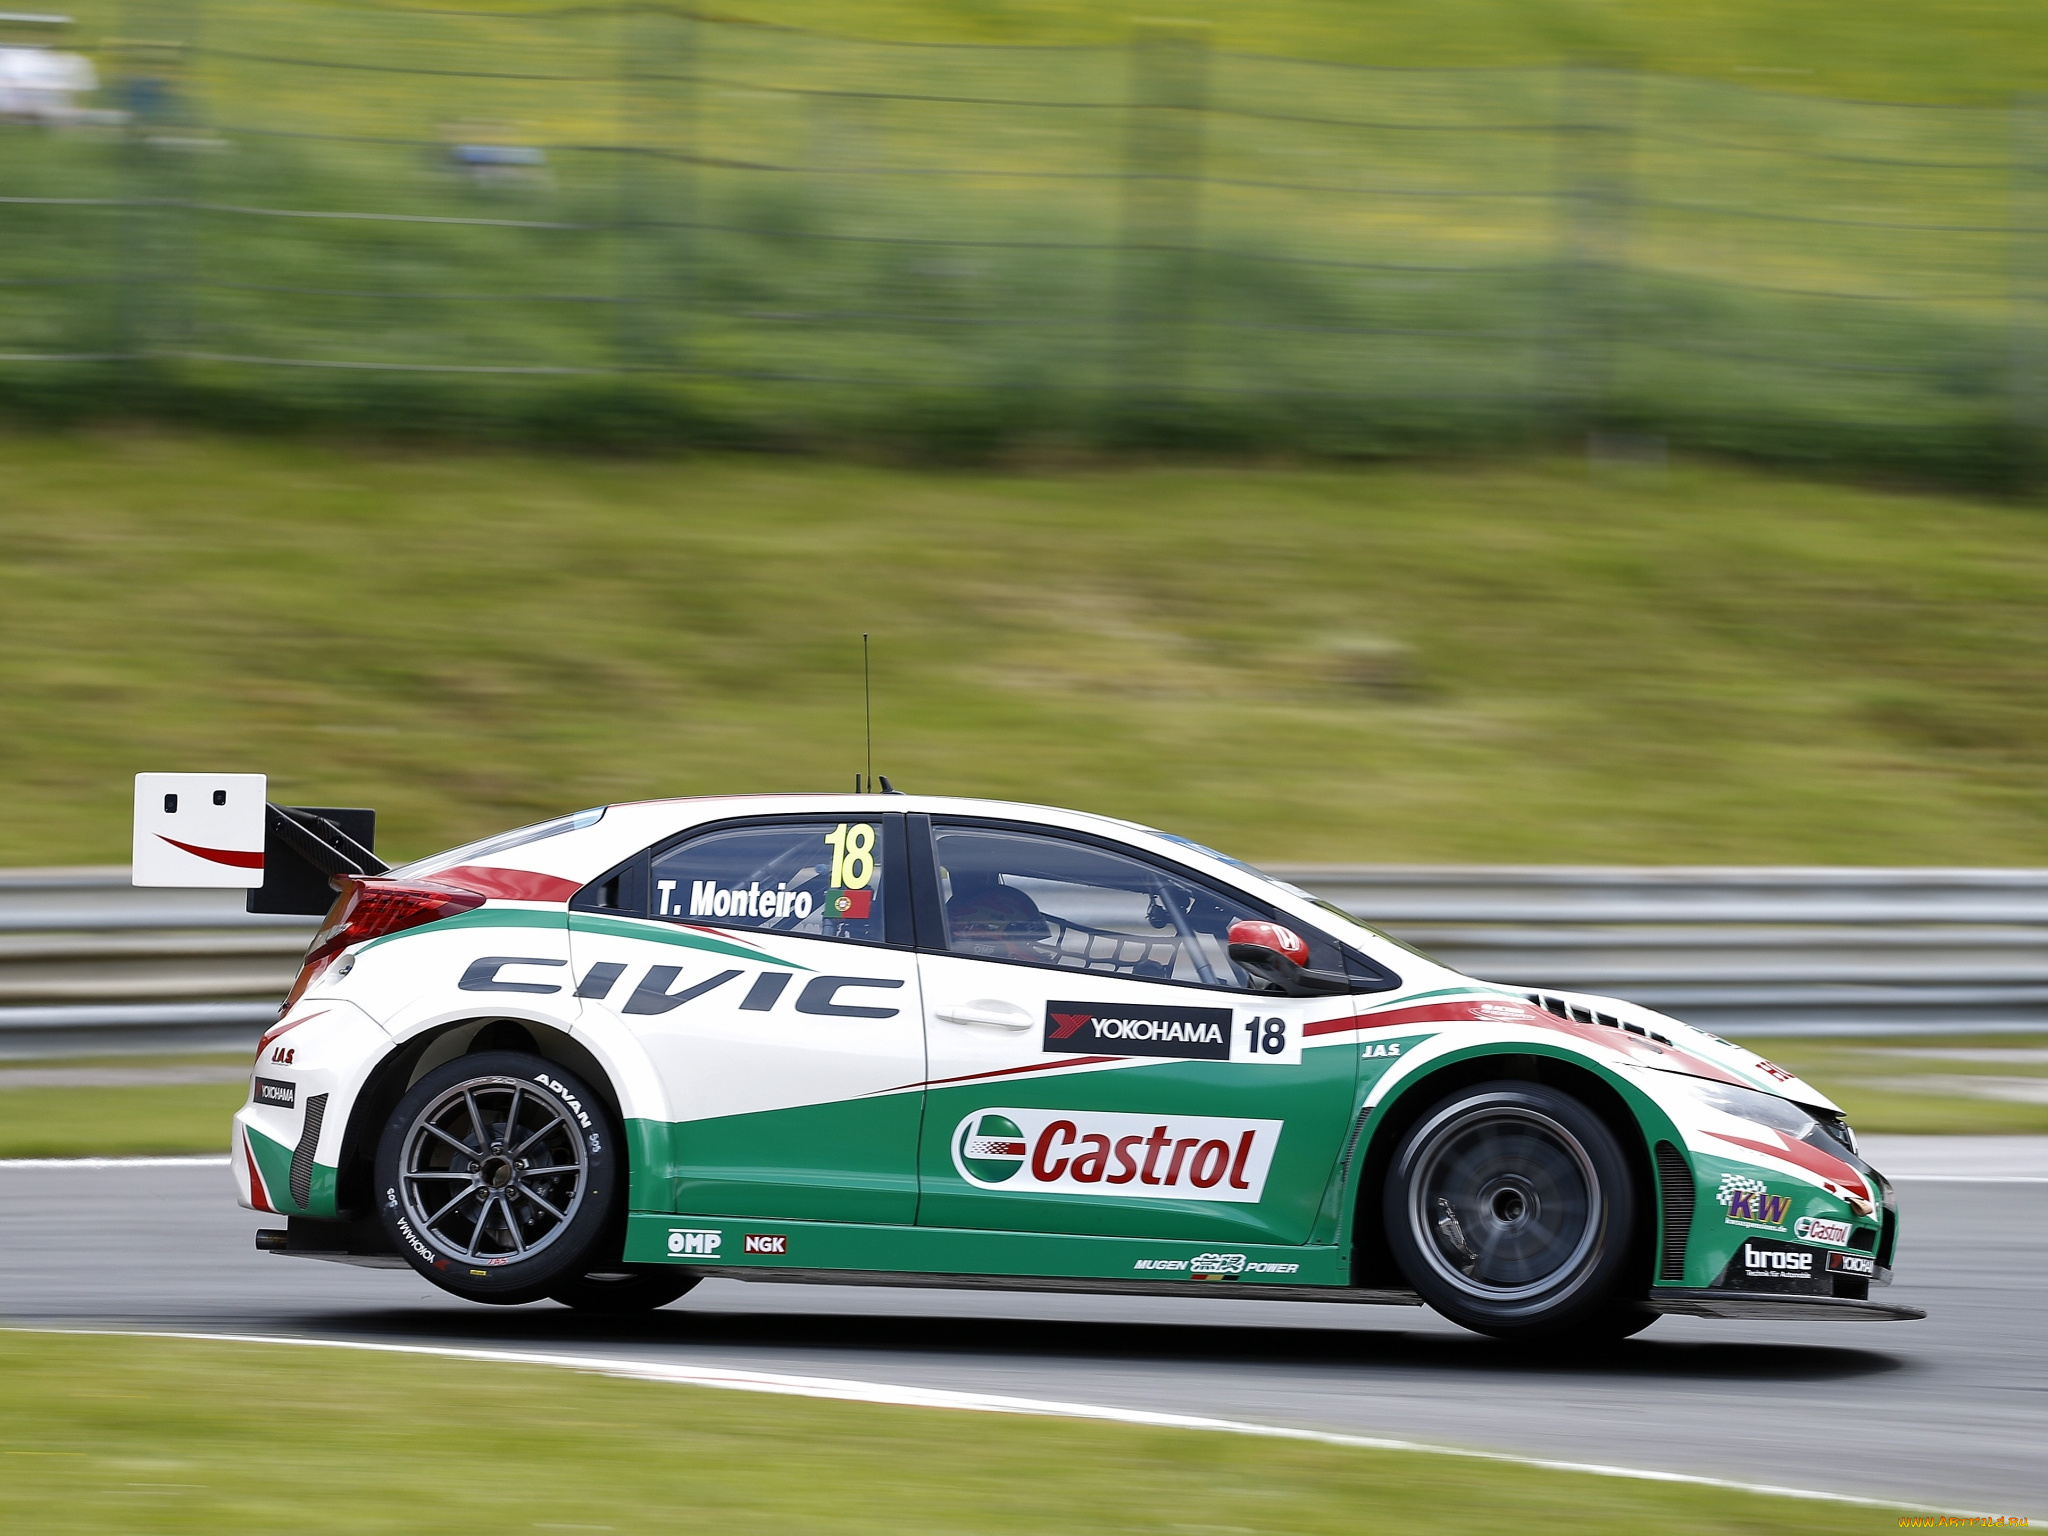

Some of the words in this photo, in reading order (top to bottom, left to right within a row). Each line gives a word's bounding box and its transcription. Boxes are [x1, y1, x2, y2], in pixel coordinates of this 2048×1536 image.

[824, 823, 876, 890] 18
[657, 880, 682, 916] T.
[689, 880, 812, 919] Monteiro
[458, 956, 905, 1019] CIVIC
[1090, 1017, 1224, 1044] YOKOHAMA
[1245, 1016, 1286, 1055] 18
[262, 1084, 293, 1102] YOKOHAMA
[533, 1073, 593, 1129] ADVAN
[1032, 1120, 1257, 1190] Castrol
[1727, 1190, 1791, 1225] KW
[397, 1216, 436, 1264] YOKOHAMA
[667, 1232, 722, 1254] OMP
[745, 1236, 785, 1253] NGK
[1810, 1220, 1849, 1243] Castrol
[1133, 1259, 1189, 1271] MUGEN
[1244, 1262, 1299, 1274] POWER
[1744, 1243, 1813, 1270] brose
